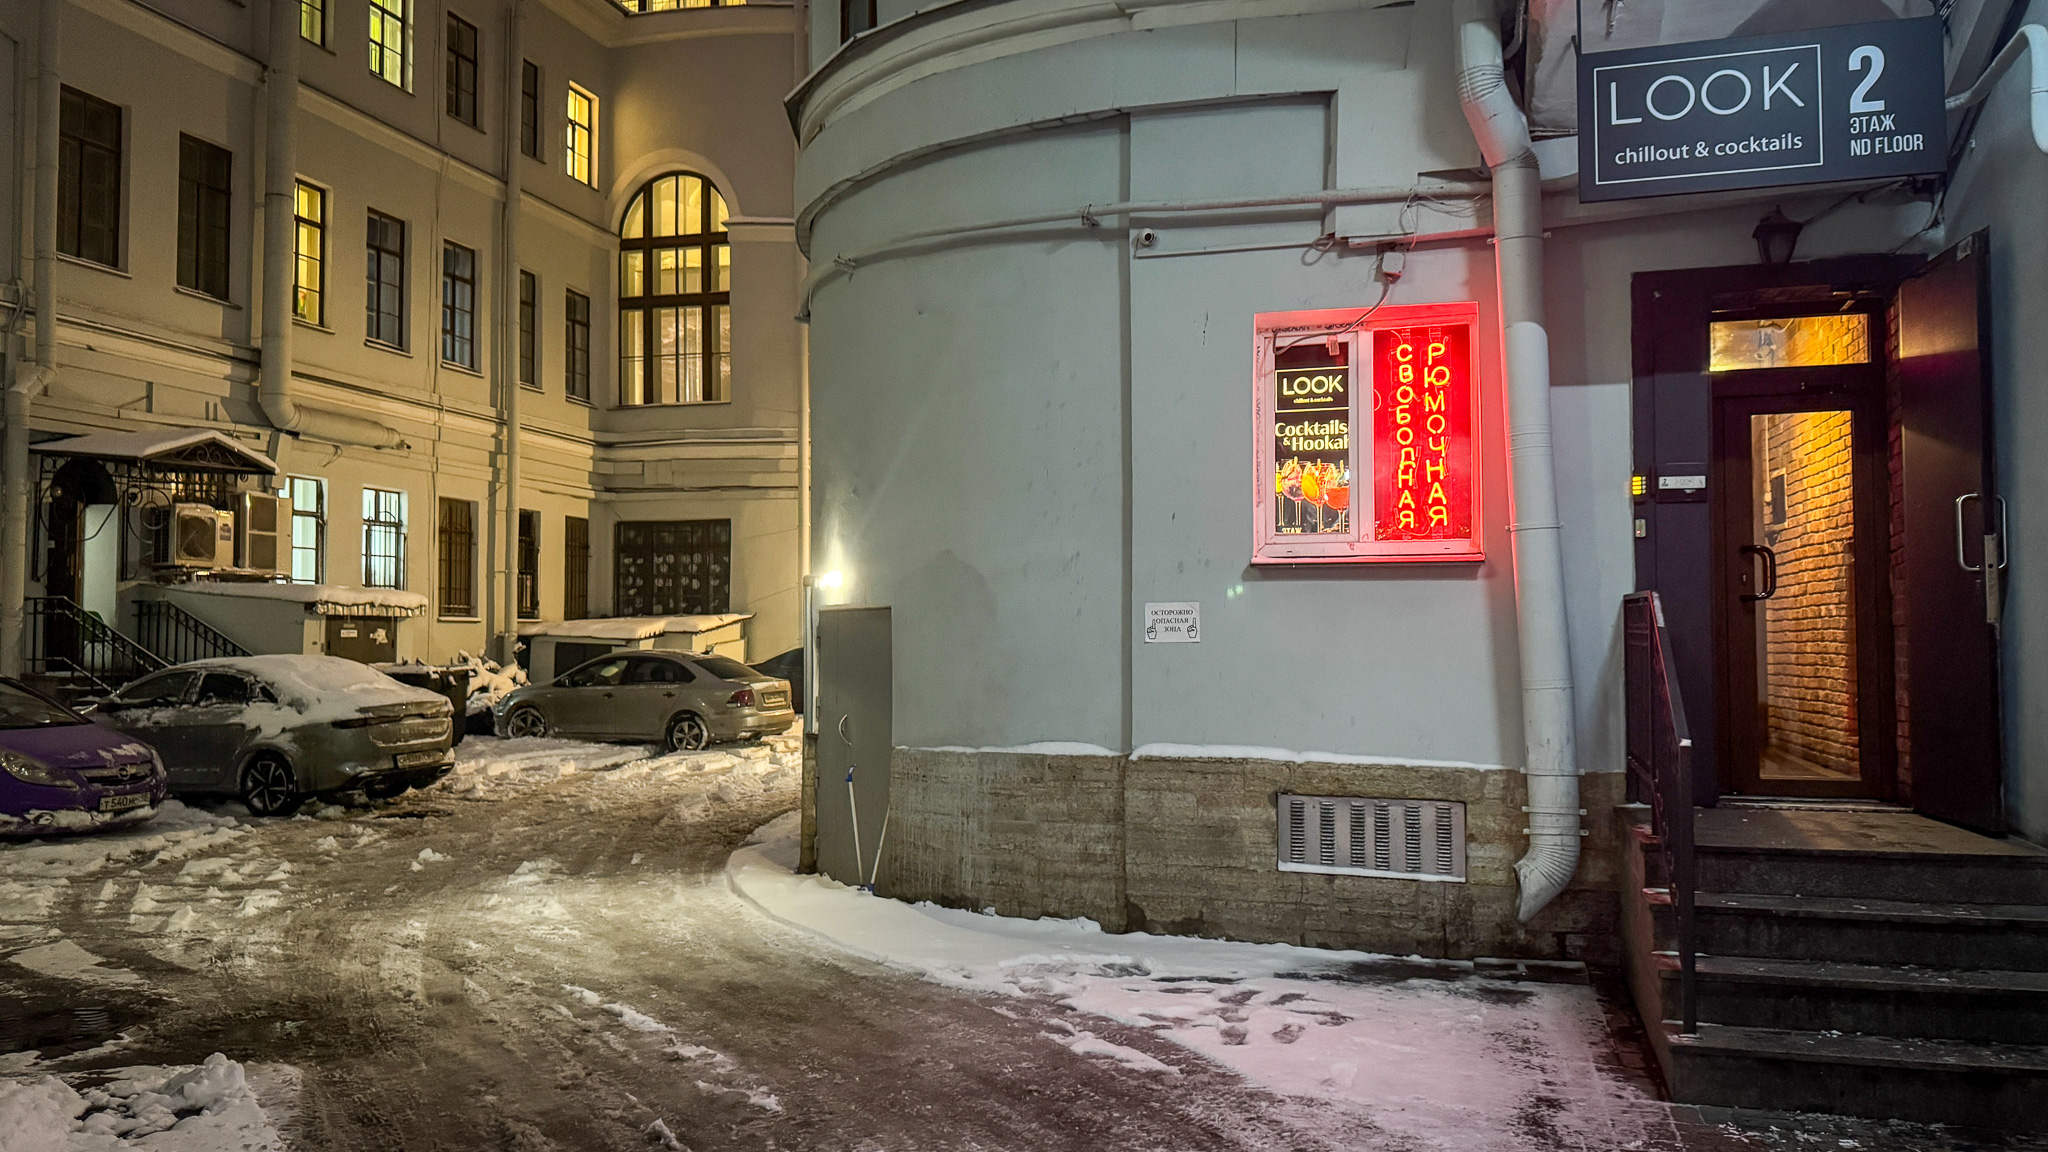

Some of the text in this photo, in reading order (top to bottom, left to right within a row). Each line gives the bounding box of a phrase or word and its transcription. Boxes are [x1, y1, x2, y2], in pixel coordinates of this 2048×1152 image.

[1848, 44, 1885, 114] 2
[1610, 62, 1805, 126] LOOK
[1850, 113, 1896, 134] ЭТАЖ
[1615, 132, 1803, 165] chillout & cocktails
[1850, 133, 1924, 156] ND FLOOR
[1283, 374, 1344, 395] LOOK
[1275, 420, 1348, 437] Cocktails
[1283, 437, 1291, 446] &
[1396, 344, 1416, 529] СВОБОДНАЯ
[1424, 343, 1450, 527] РЮМОЧНАЯ
